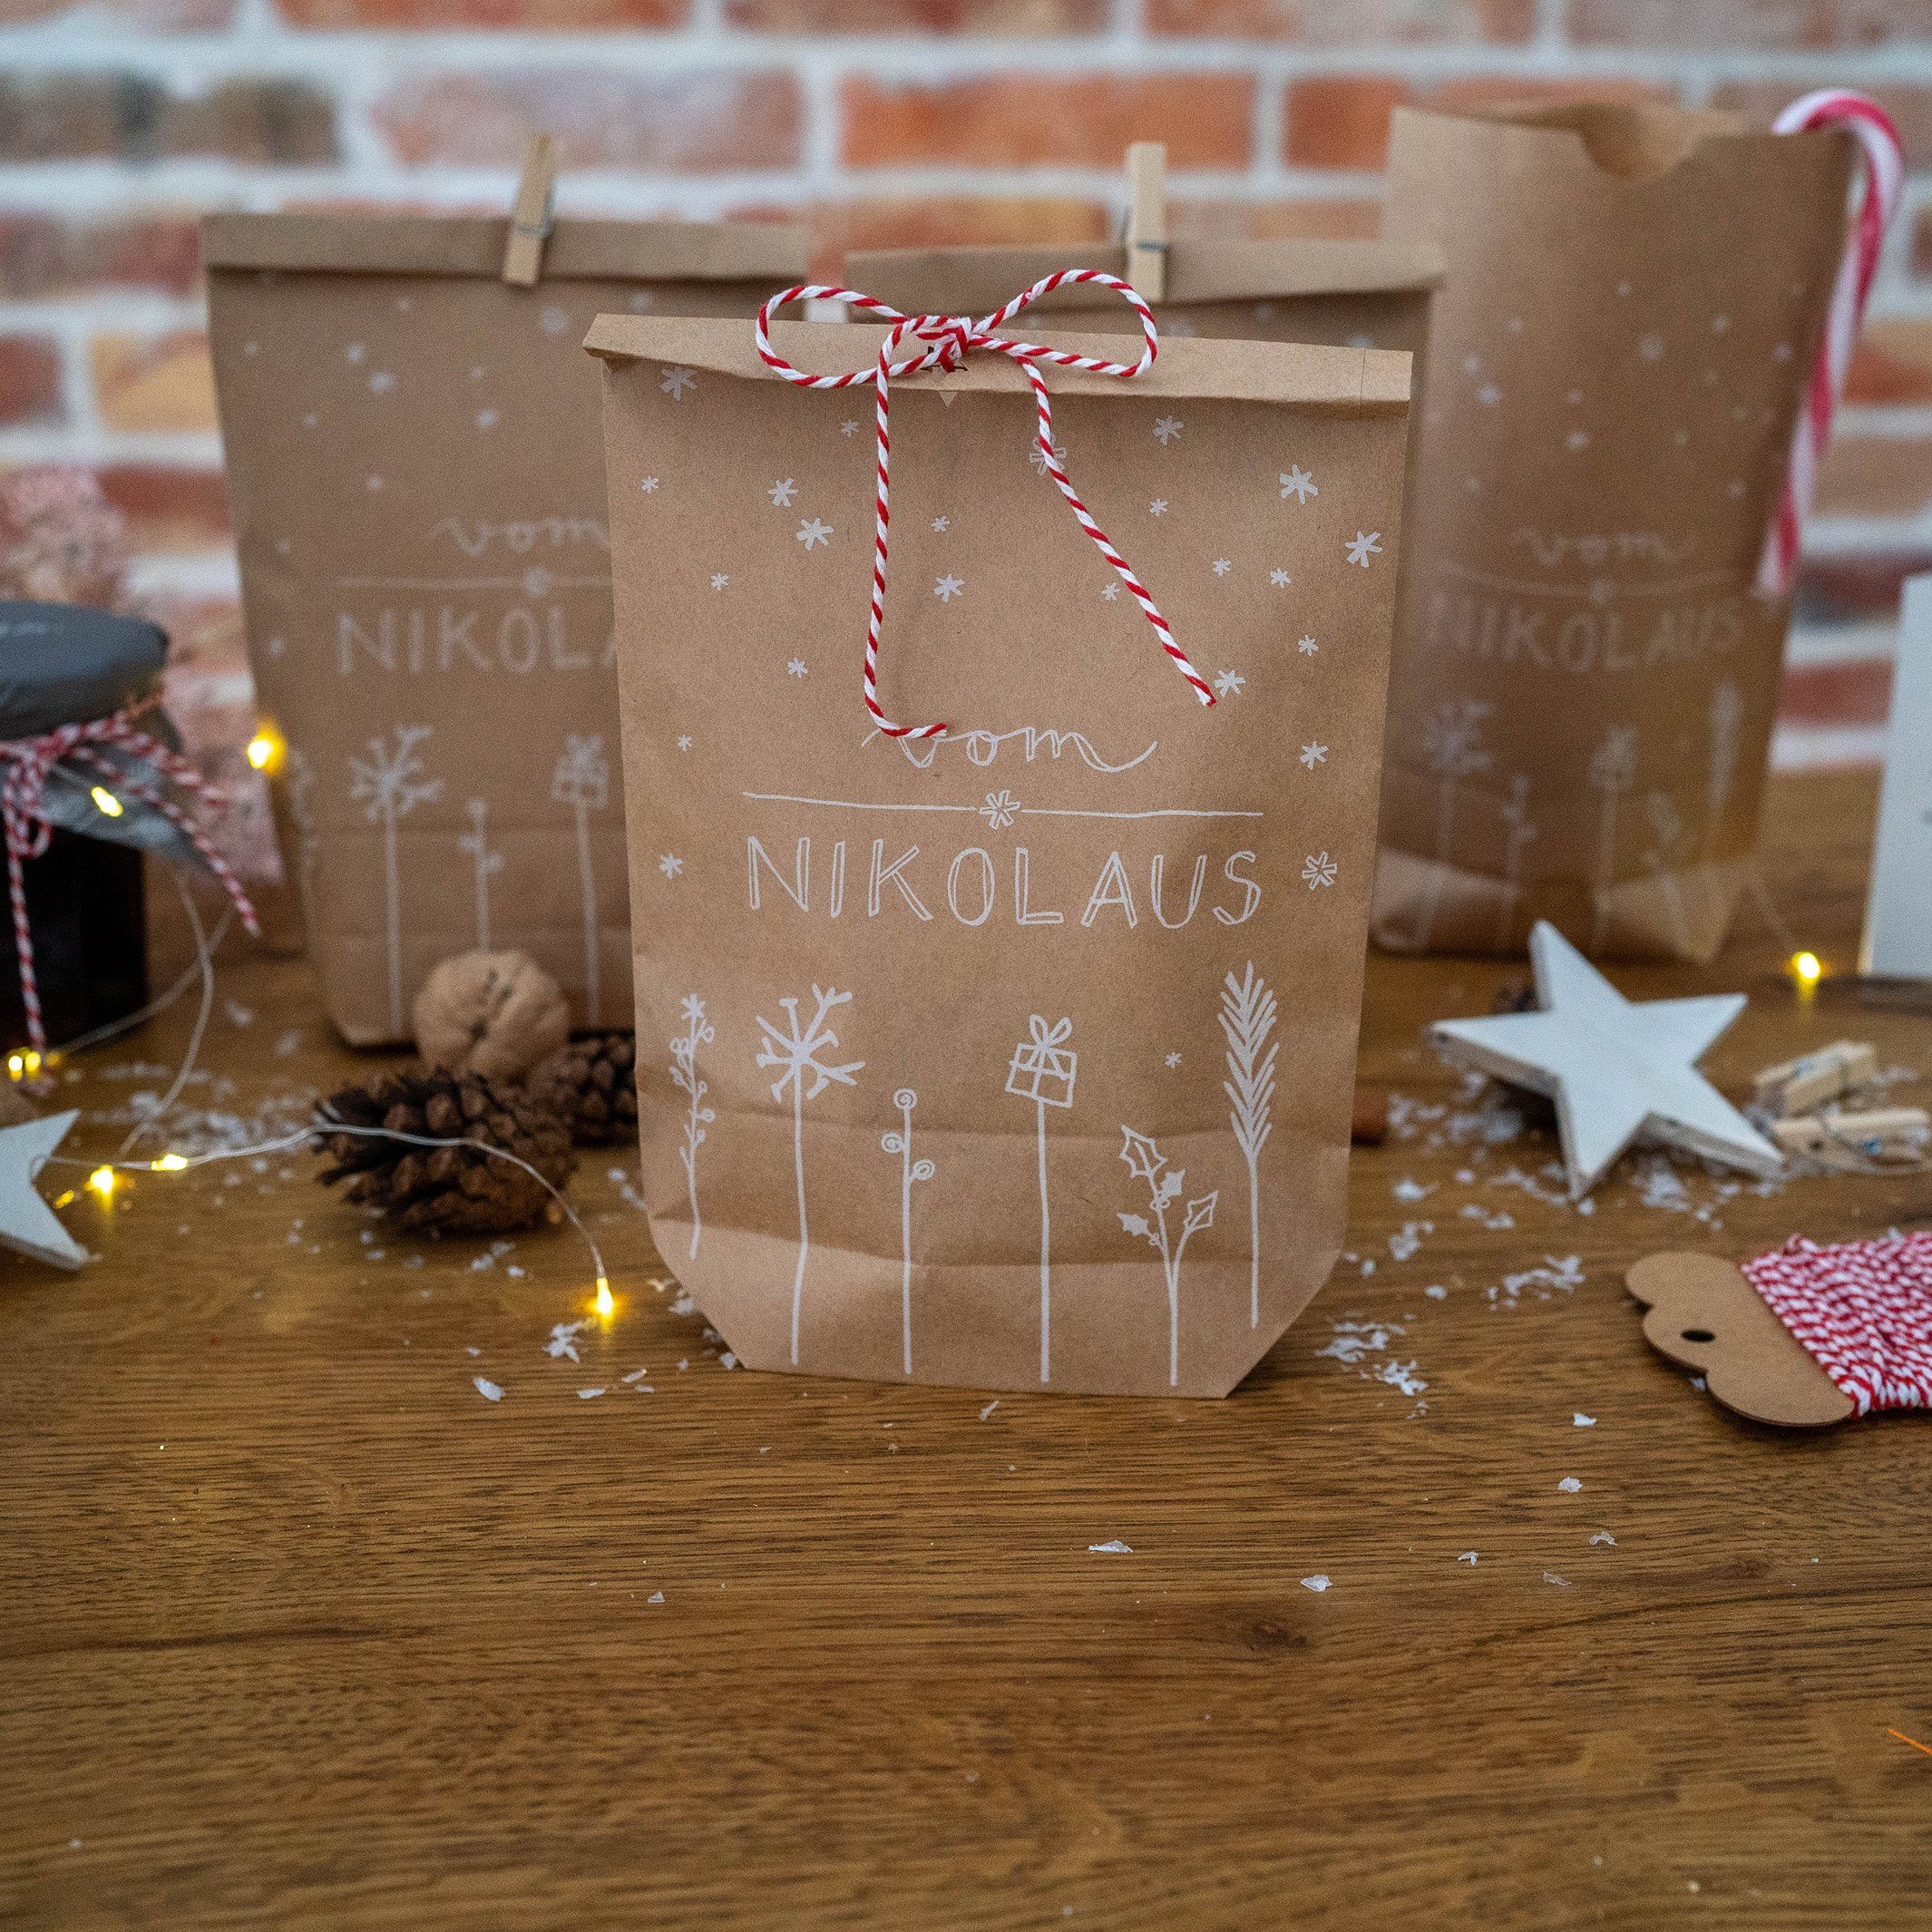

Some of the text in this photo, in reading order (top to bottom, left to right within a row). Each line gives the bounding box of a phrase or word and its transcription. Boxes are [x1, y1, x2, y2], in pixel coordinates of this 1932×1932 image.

[337, 607, 616, 674] NIKOL
[862, 727, 1158, 773] vom
[747, 836, 1262, 929] NIKOLAUS
